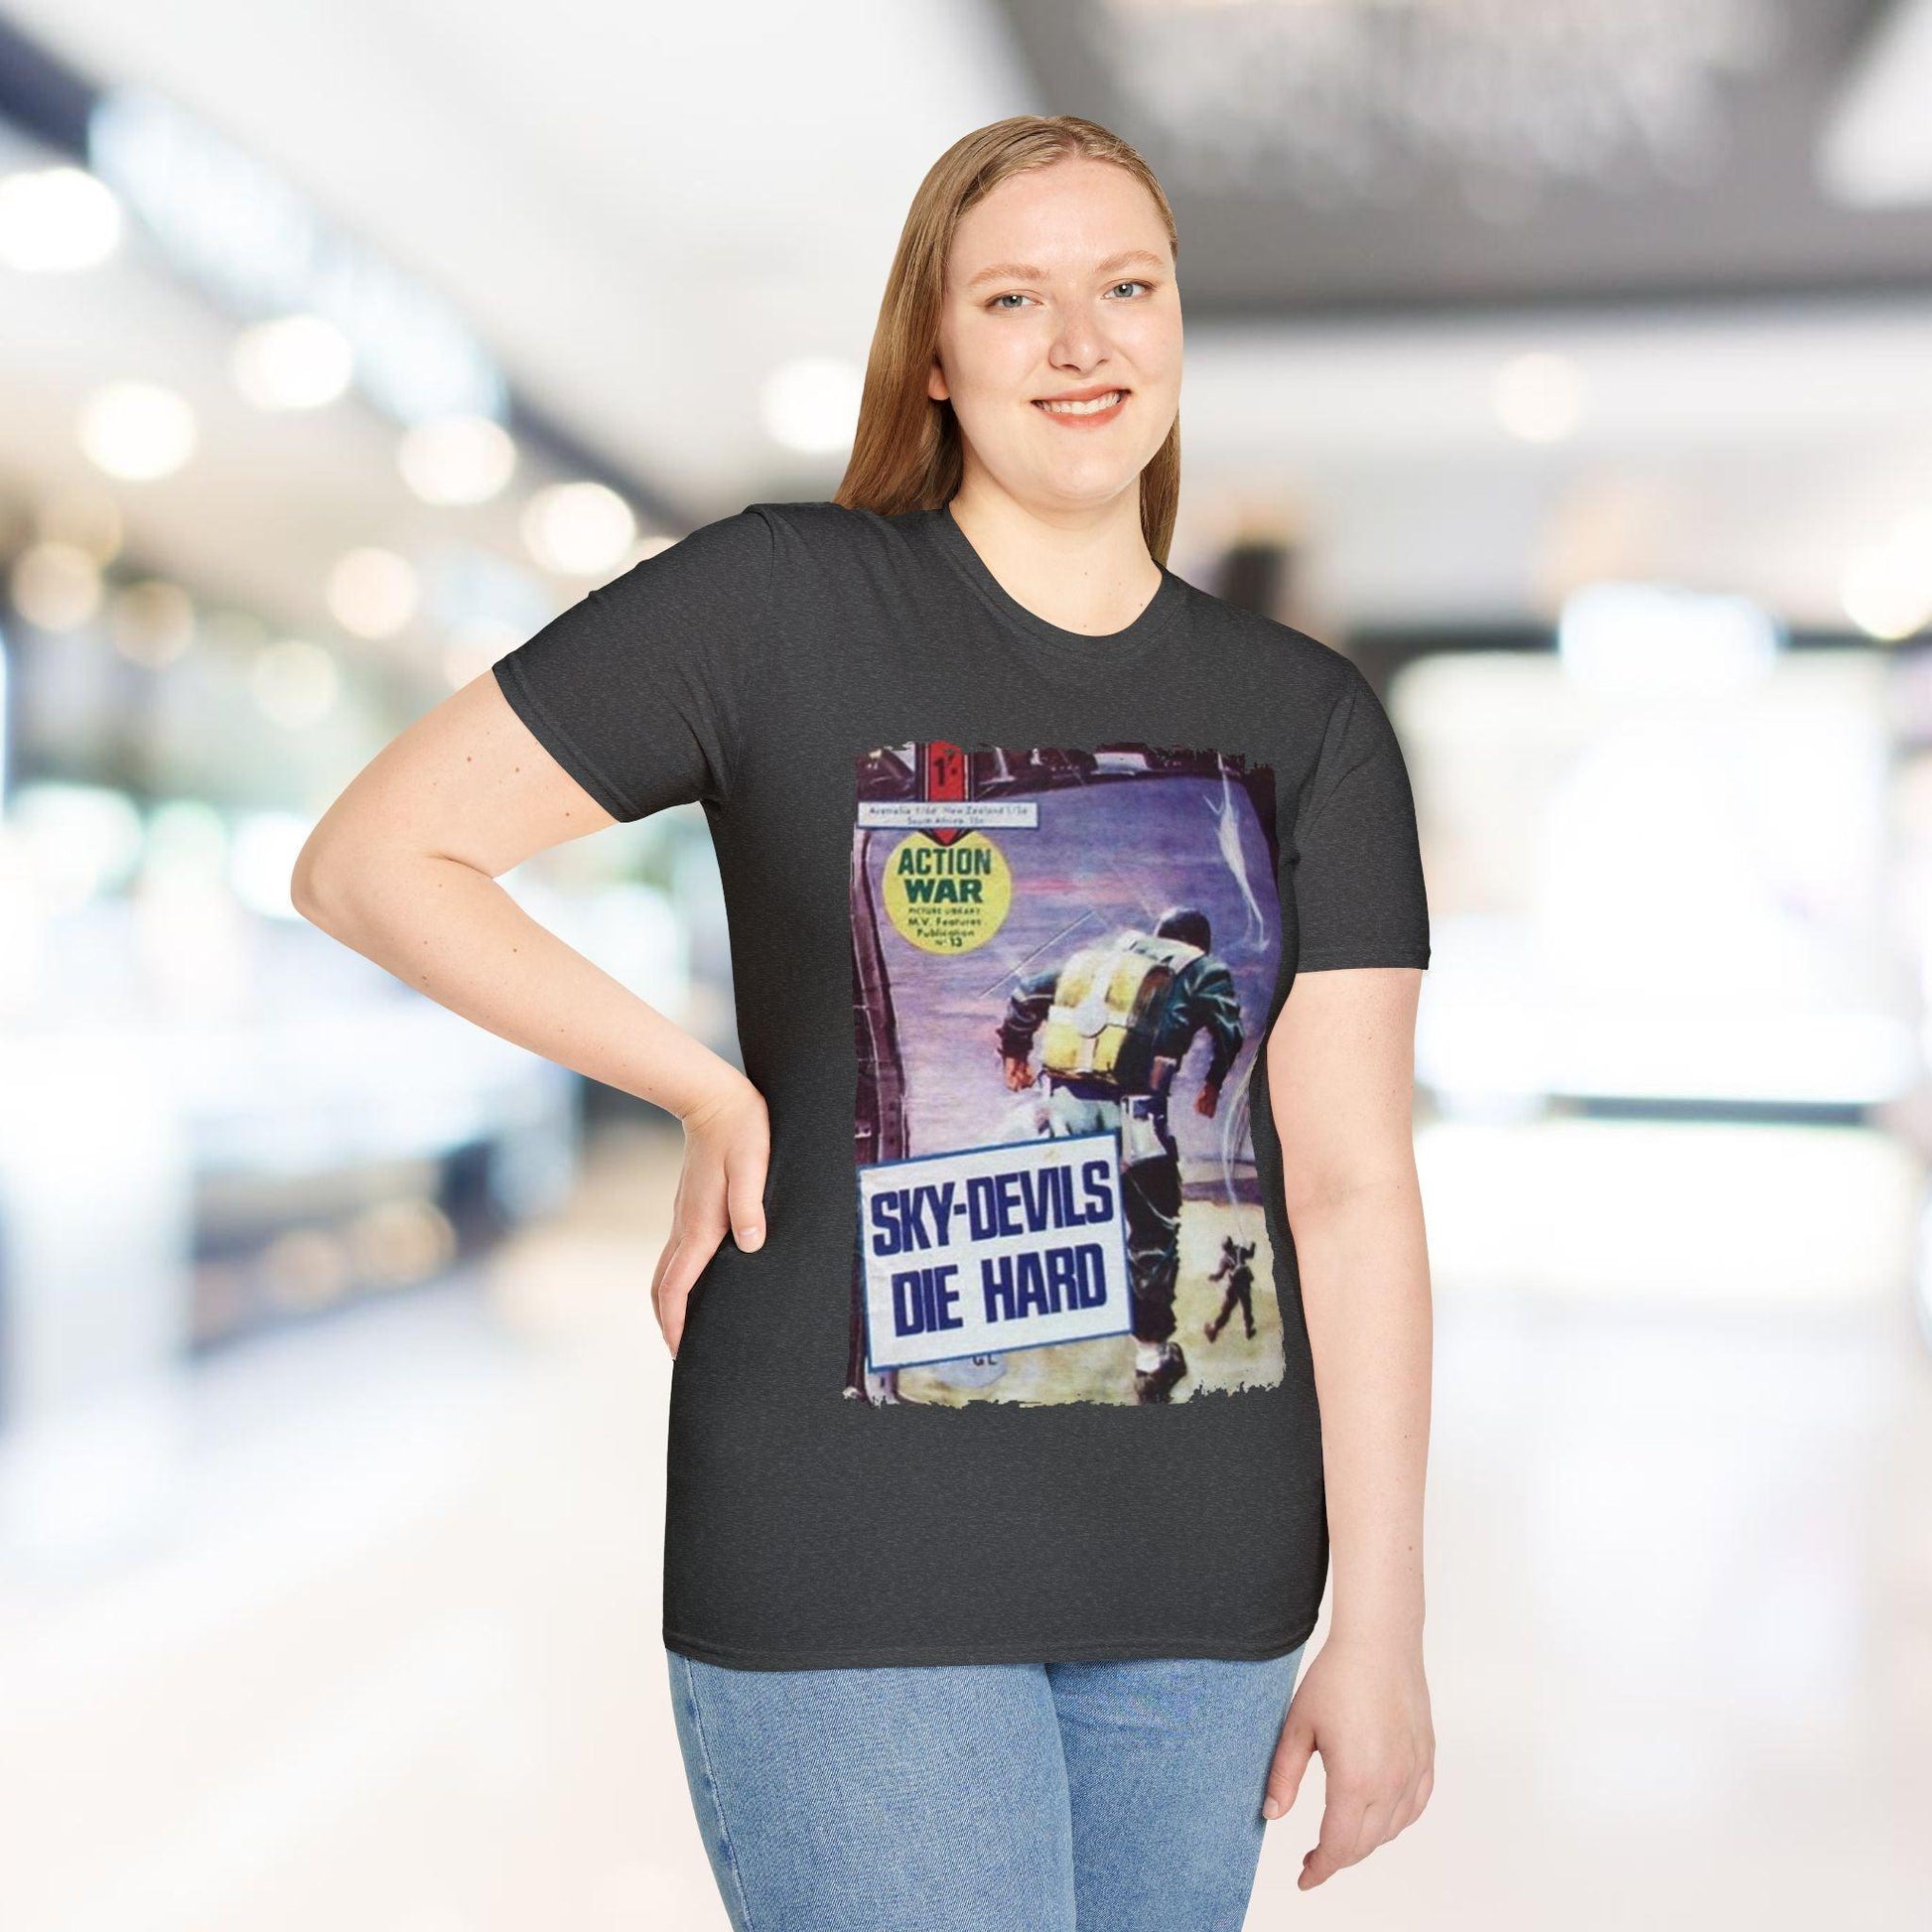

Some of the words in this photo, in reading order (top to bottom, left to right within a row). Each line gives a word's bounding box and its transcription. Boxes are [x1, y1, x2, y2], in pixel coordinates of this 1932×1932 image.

[944, 806, 963, 815] New
[965, 805, 1004, 815] Zealand
[897, 848, 992, 875] ACTION
[904, 879, 983, 903] WAR
[936, 916, 981, 926] Features
[916, 928, 975, 937] Publication
[950, 936, 963, 947] 13
[870, 1160, 1114, 1257] SKY-DEVILS
[892, 1265, 963, 1337] DIE
[981, 1243, 1107, 1323] HARD
